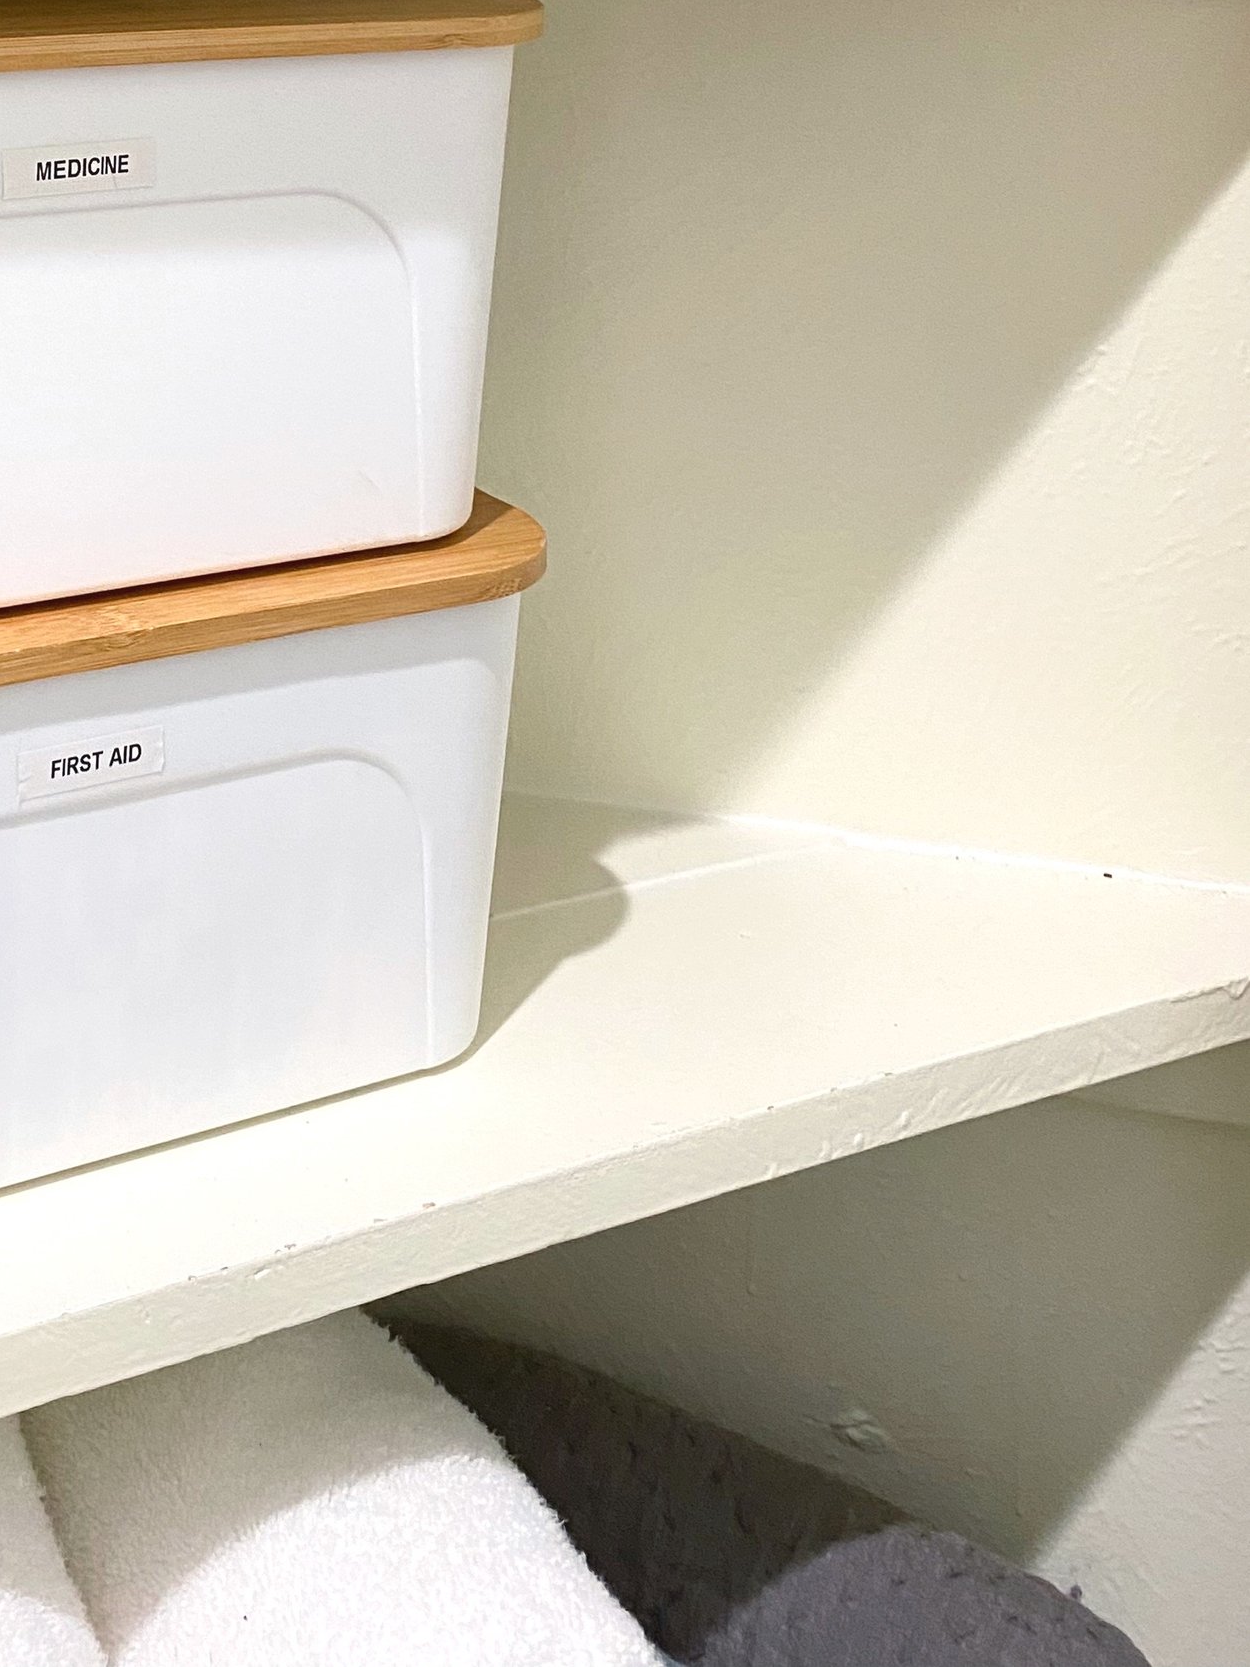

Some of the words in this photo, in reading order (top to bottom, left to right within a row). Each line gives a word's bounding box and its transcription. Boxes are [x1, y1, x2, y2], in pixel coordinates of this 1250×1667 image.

[36, 154, 130, 181] MEDICINE
[50, 750, 104, 780] FIRST
[108, 743, 142, 769] AID
